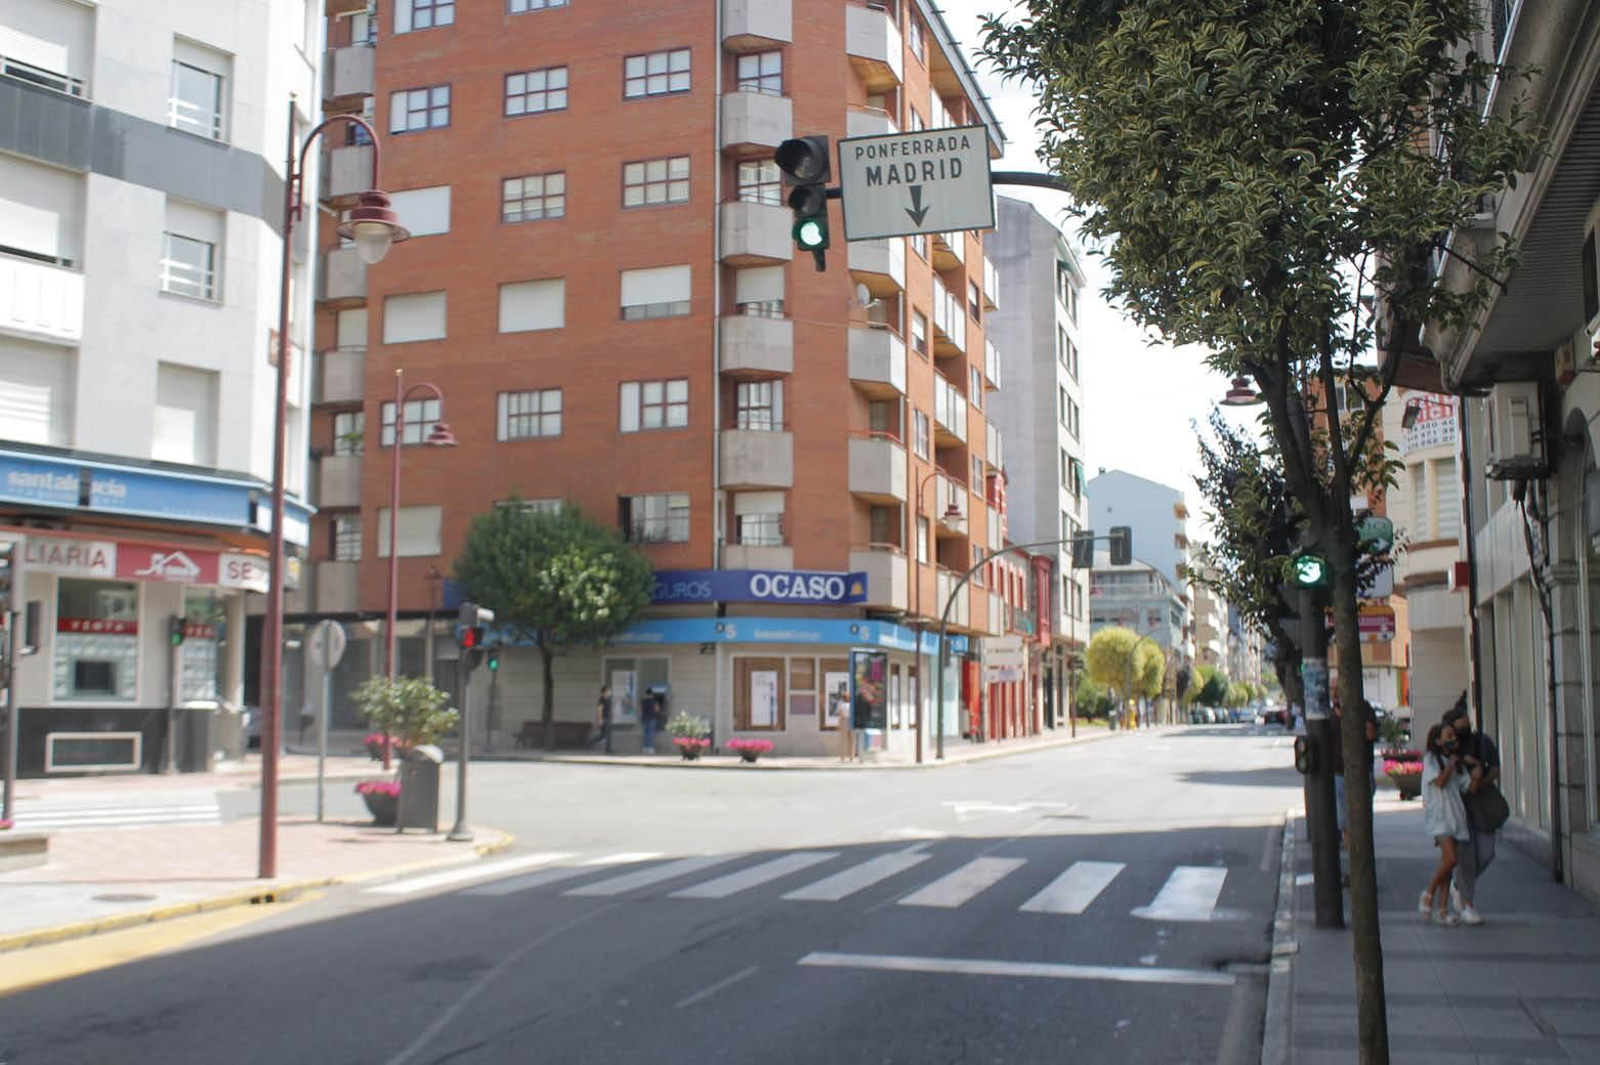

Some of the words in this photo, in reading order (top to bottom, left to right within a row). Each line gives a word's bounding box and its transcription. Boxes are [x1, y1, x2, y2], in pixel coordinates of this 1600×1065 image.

[855, 135, 971, 160] PONFERRADA
[866, 158, 963, 187] MADRID
[750, 573, 846, 601] OCASO
